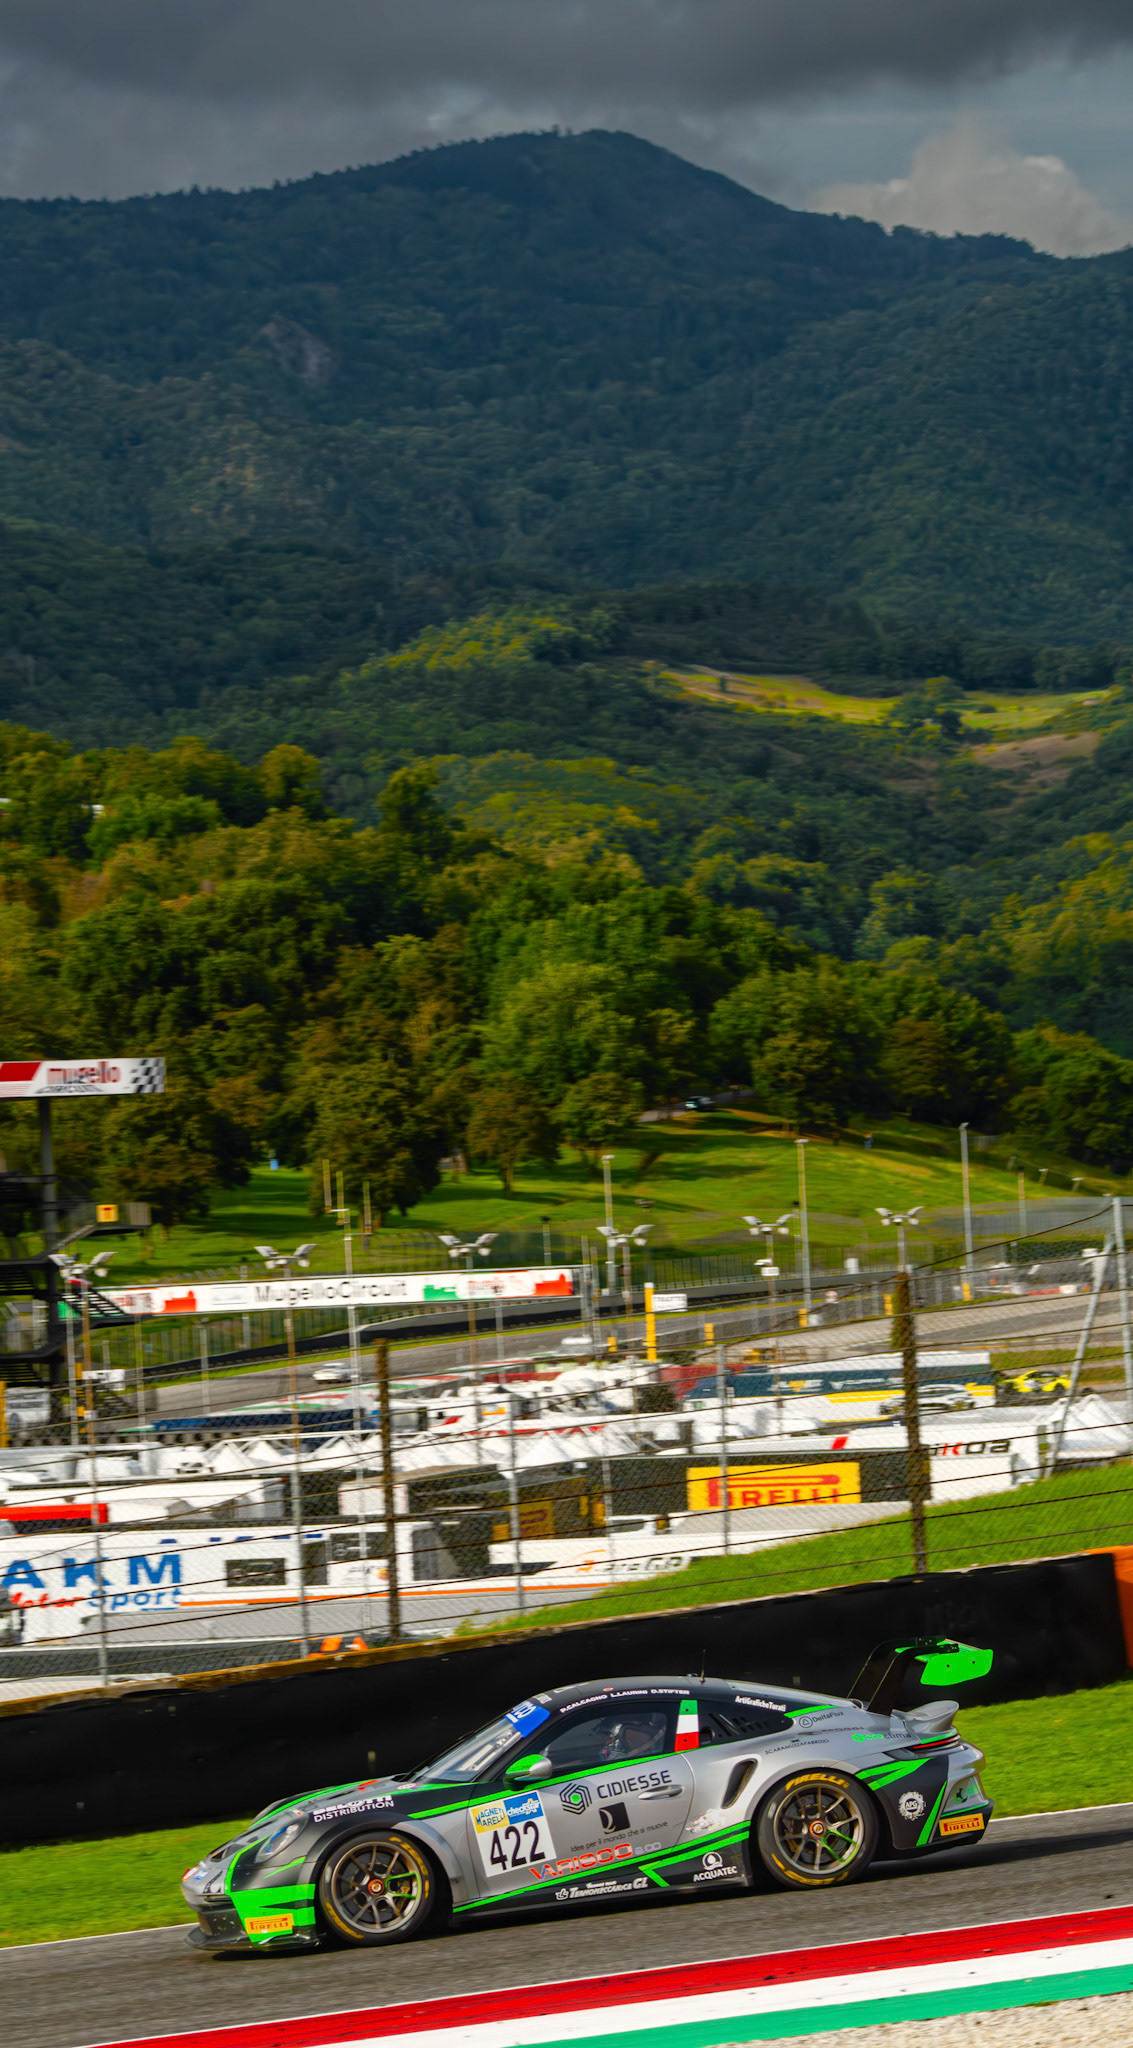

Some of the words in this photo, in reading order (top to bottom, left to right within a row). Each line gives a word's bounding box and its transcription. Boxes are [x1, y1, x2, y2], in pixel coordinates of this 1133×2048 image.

[708, 1474, 840, 1507] PIRELLI
[1, 1554, 182, 1588] AKM
[88, 1588, 183, 1610] Sport
[560, 1694, 607, 1713] P.CALCAGNO
[812, 1711, 844, 1723] DeltaFlux
[596, 1770, 672, 1799] CIDIESSE
[313, 1800, 394, 1823] DISTRIBUTION
[943, 1817, 980, 1832] PIRELLI
[490, 1820, 546, 1871] 422
[586, 1841, 597, 1850] per
[603, 1833, 626, 1844] mondo
[529, 1843, 633, 1880] VARISCO
[693, 1866, 738, 1882] ACQUATEC
[250, 1917, 289, 1930] PIRELLI
